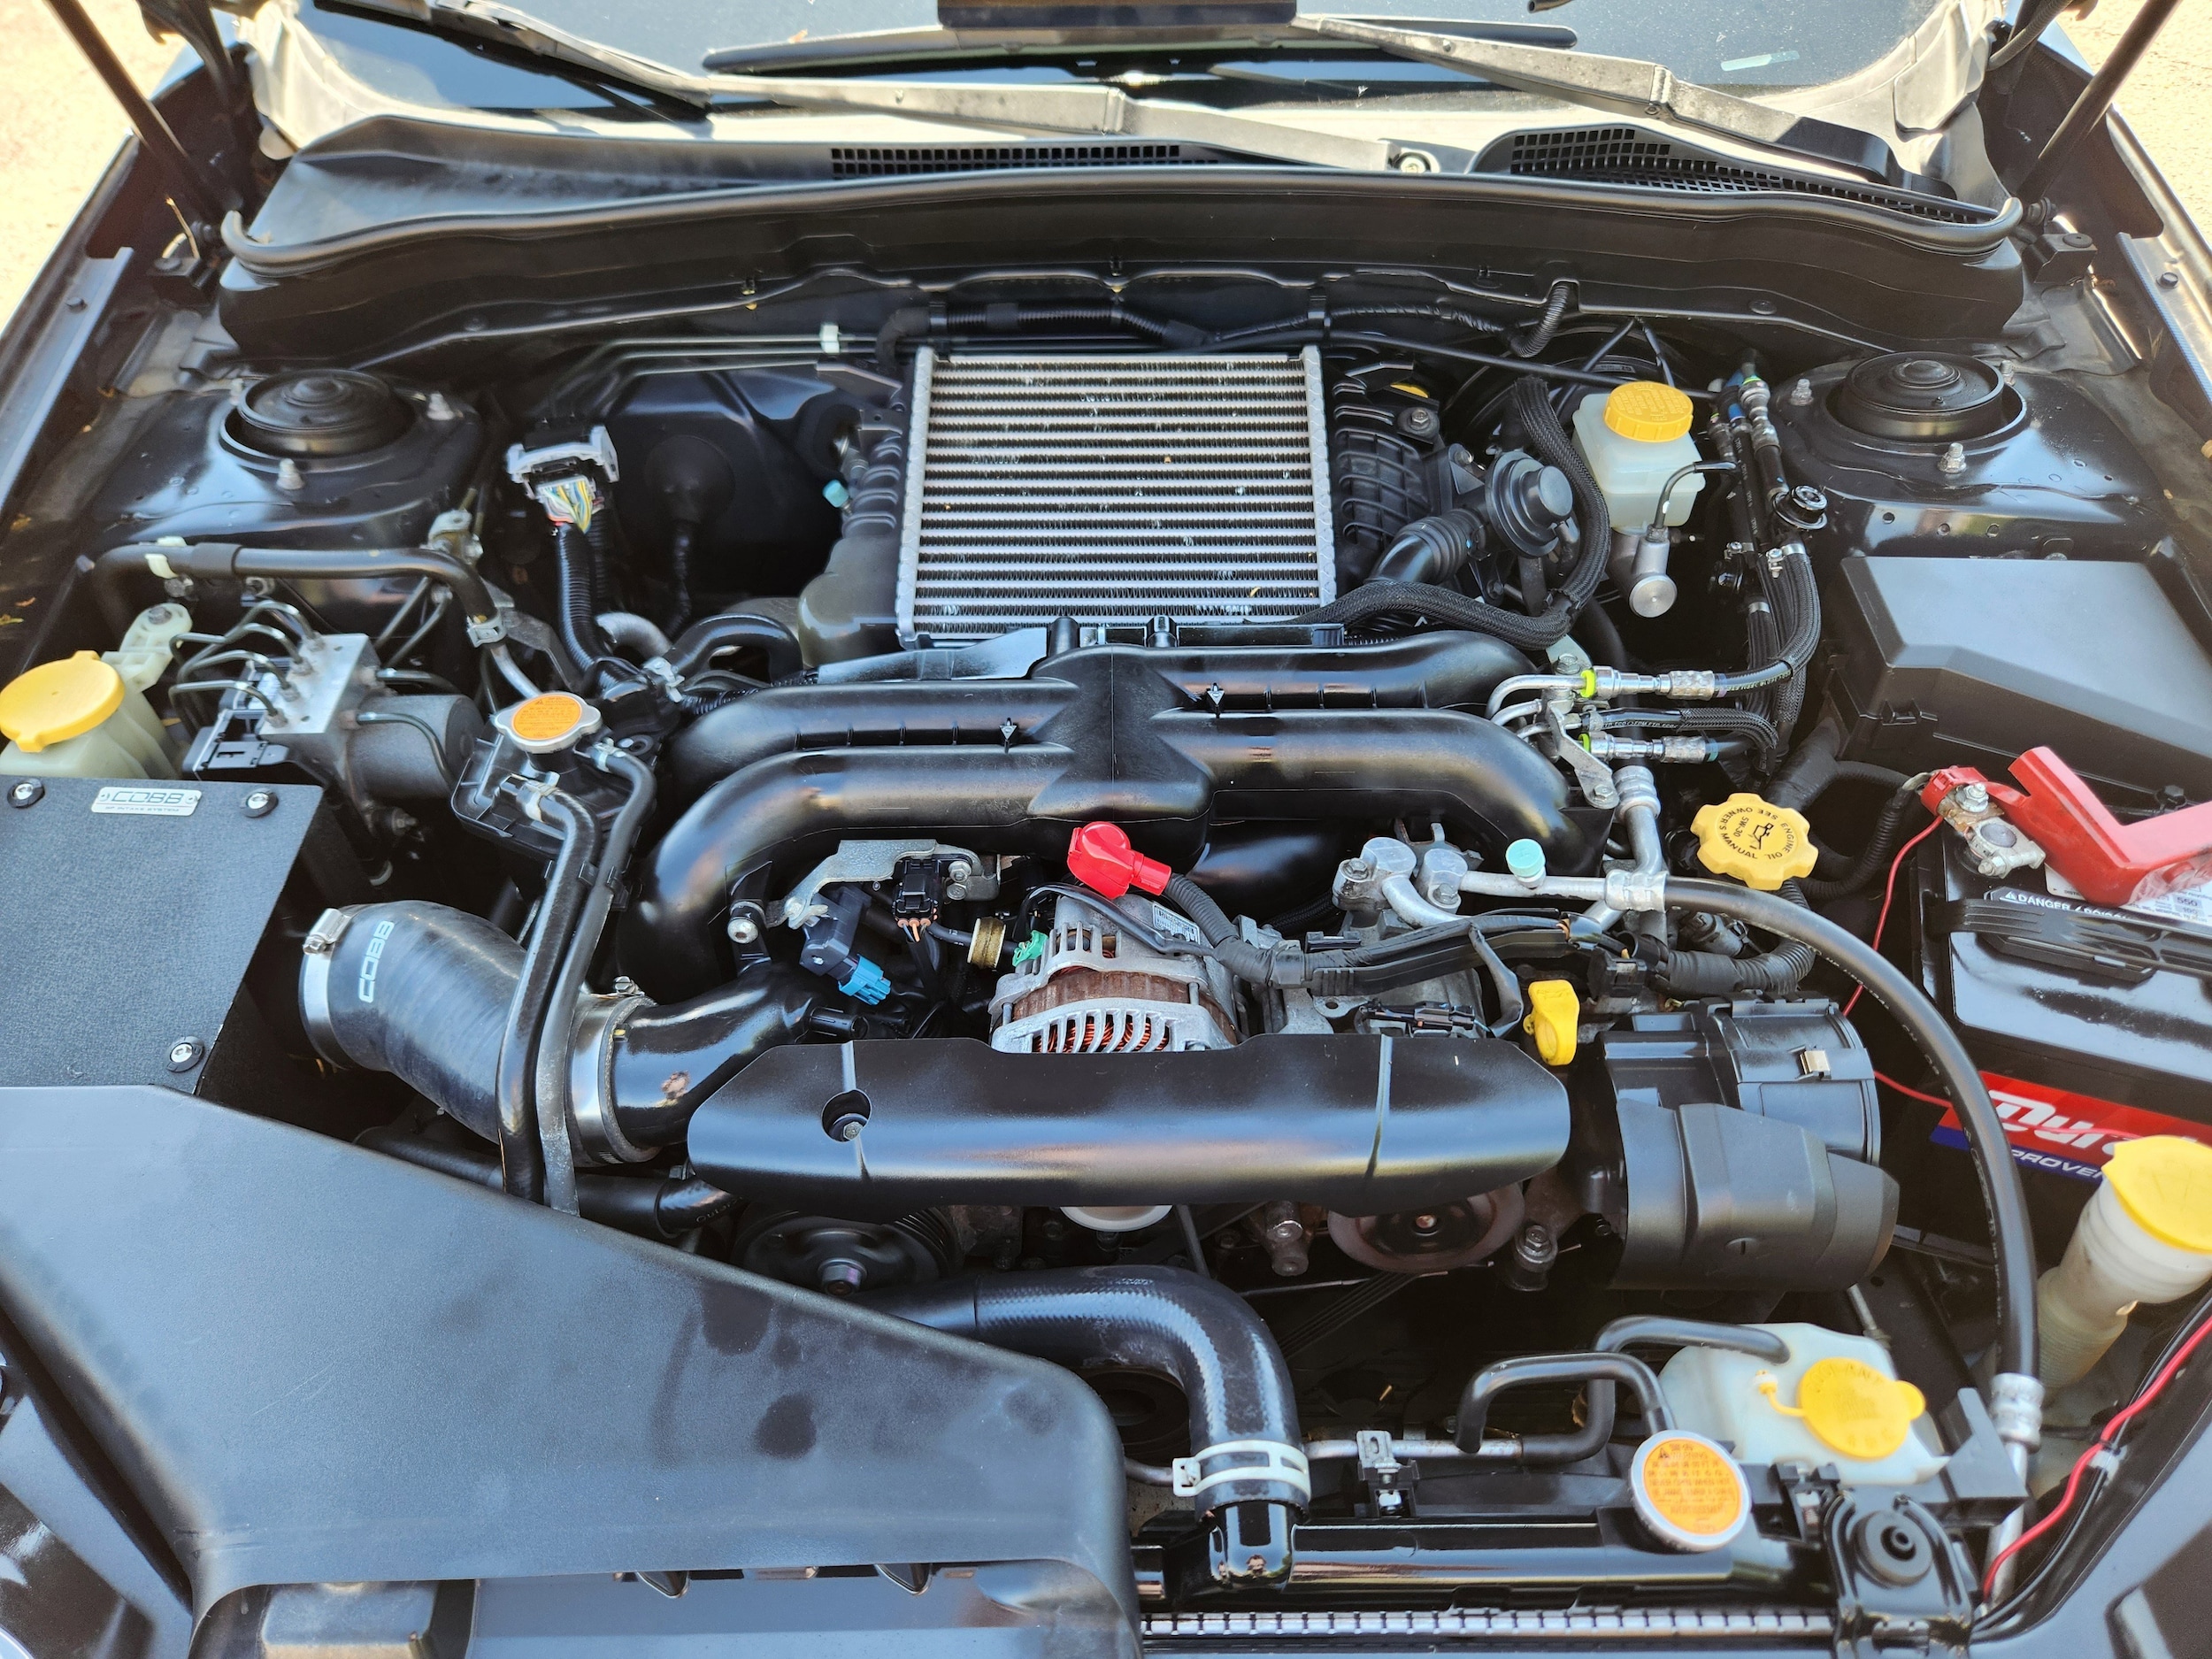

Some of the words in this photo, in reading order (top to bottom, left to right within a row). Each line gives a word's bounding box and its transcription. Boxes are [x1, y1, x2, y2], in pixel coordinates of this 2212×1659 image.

[111, 791, 184, 804] COBB
[1757, 808, 1778, 820] SEE
[1732, 816, 1749, 838] 5W-30
[1721, 833, 1758, 860] MANUAL
[1780, 822, 1794, 854] ENGINE
[1764, 851, 1783, 860] OIL
[2017, 894, 2070, 910] DANGER
[358, 920, 395, 1003] COBB
